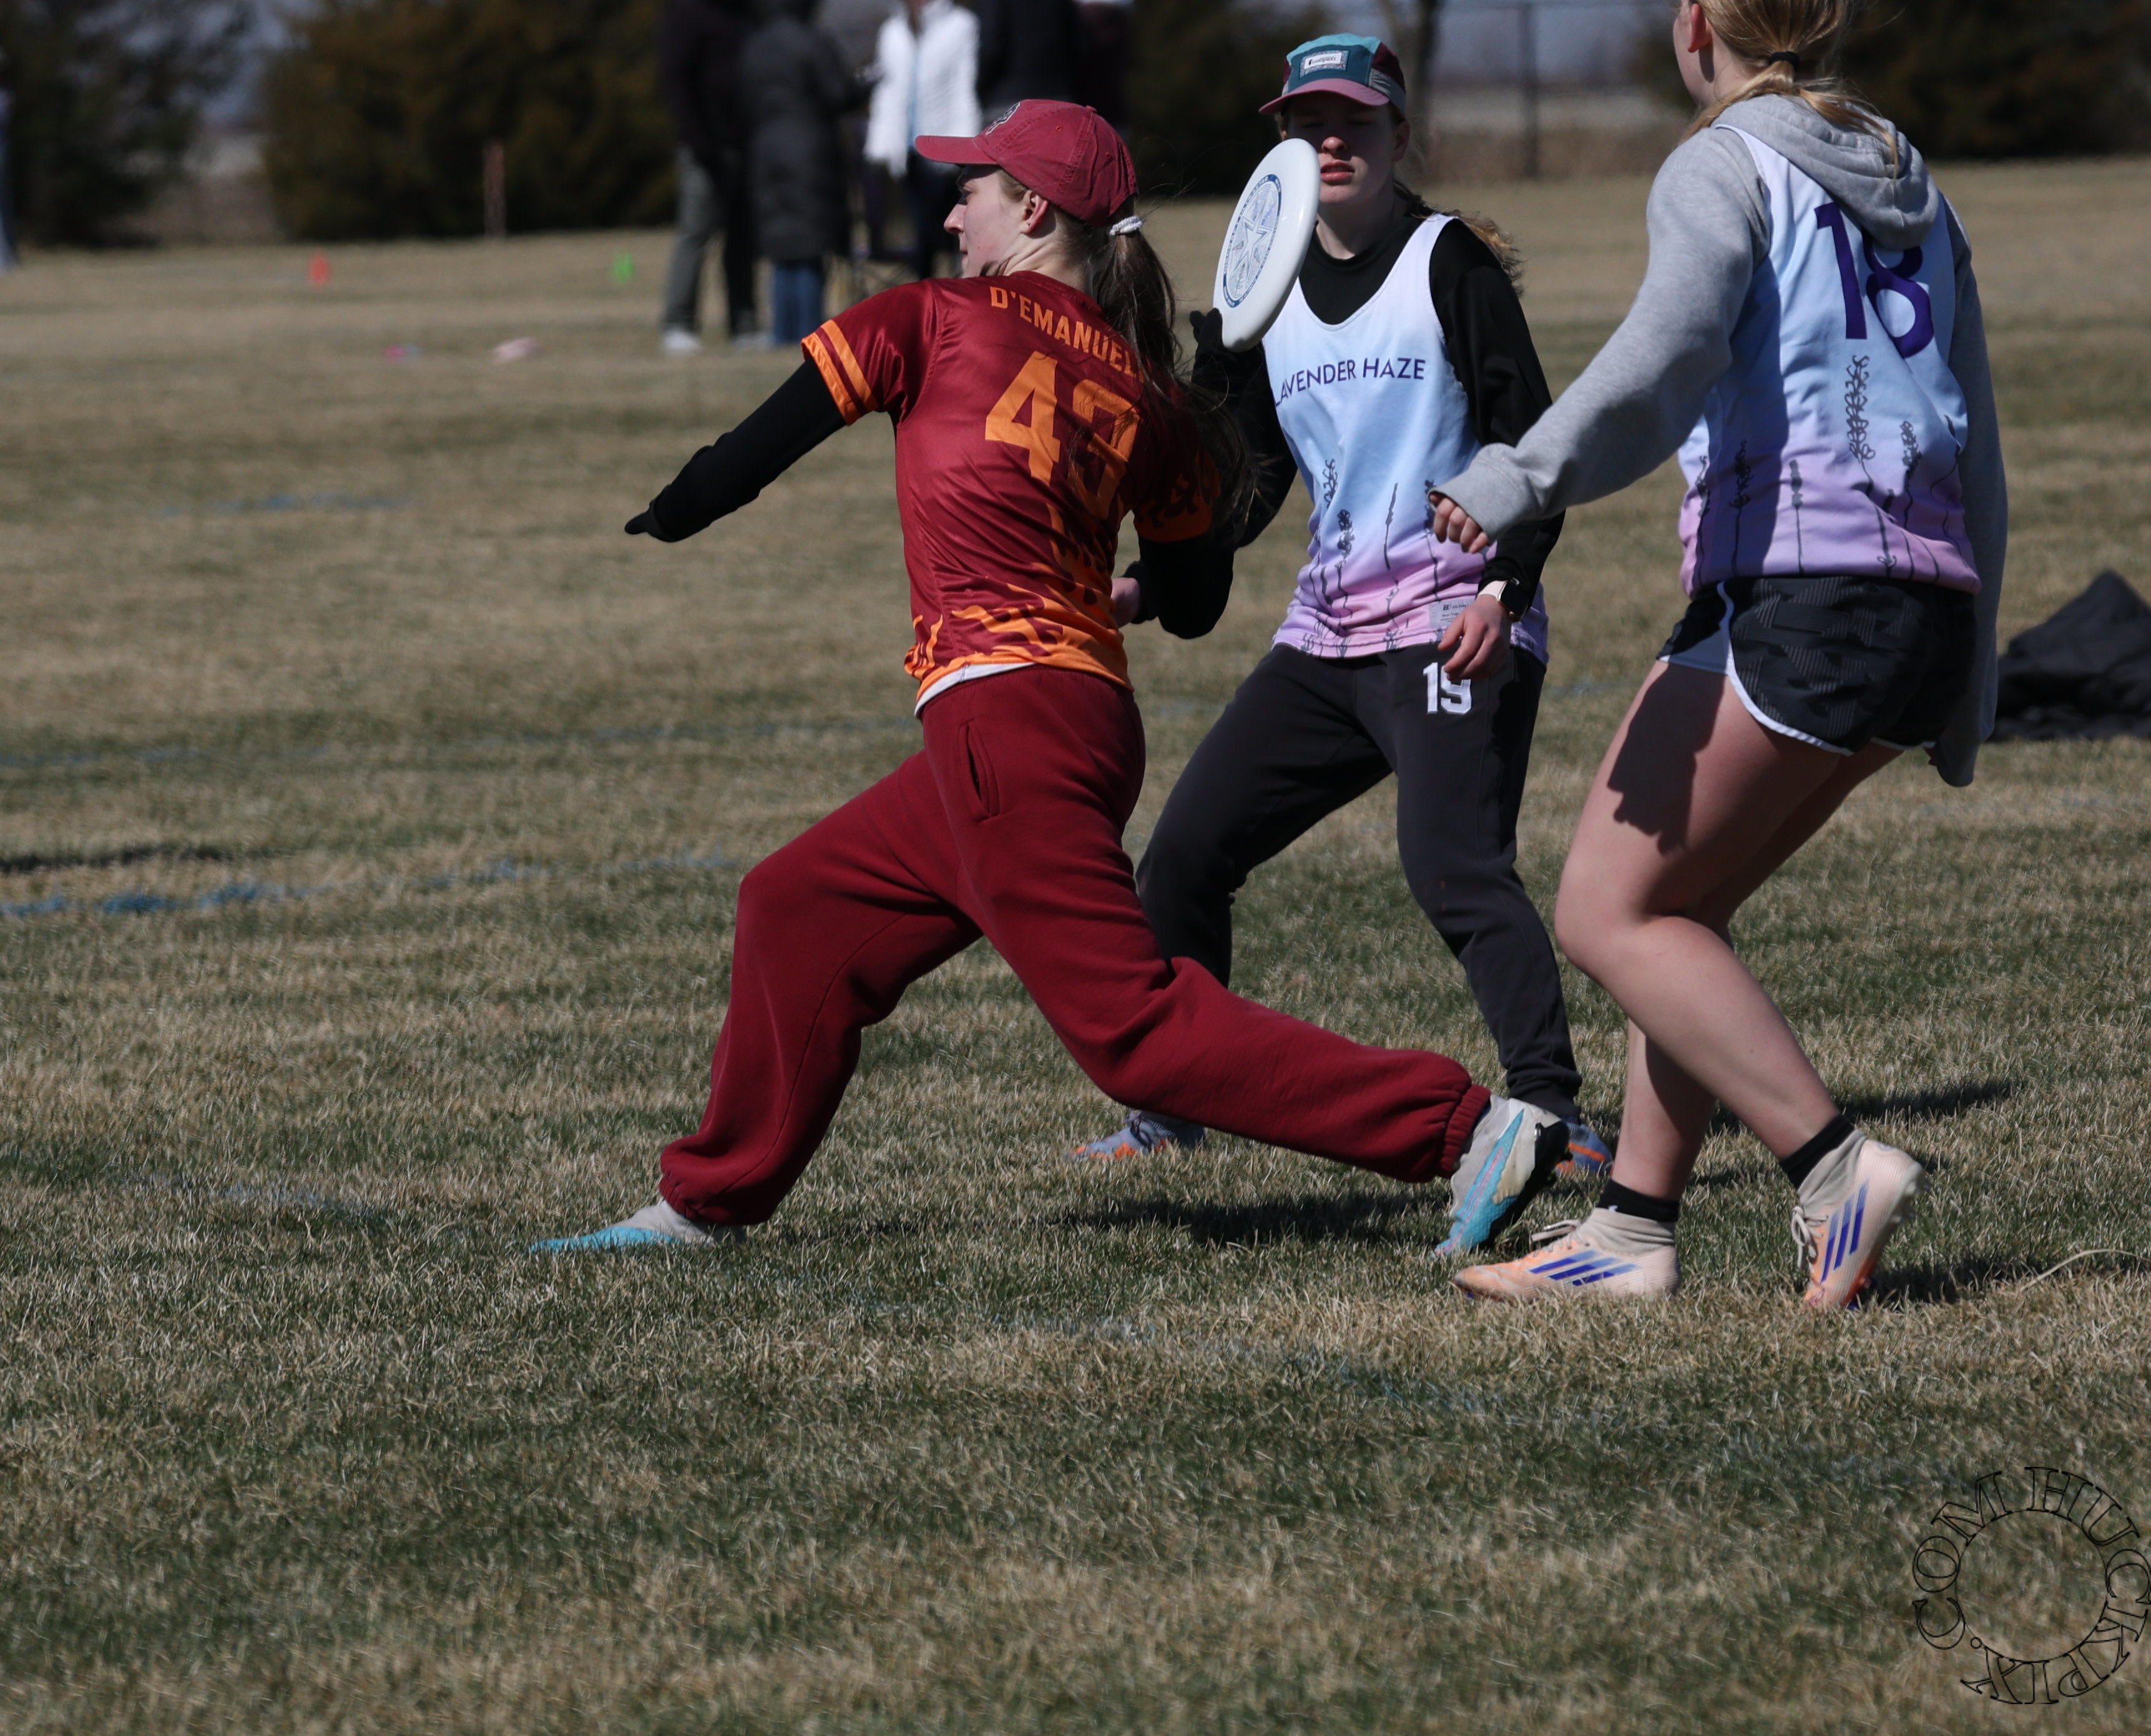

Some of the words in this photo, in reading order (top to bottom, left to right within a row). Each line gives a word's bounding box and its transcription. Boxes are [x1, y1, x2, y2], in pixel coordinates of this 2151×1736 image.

[990, 286, 1145, 383] D'EMANUEL
[1815, 201, 1934, 358] 18
[1363, 358, 1426, 380] HAZE
[985, 350, 1140, 520] 43
